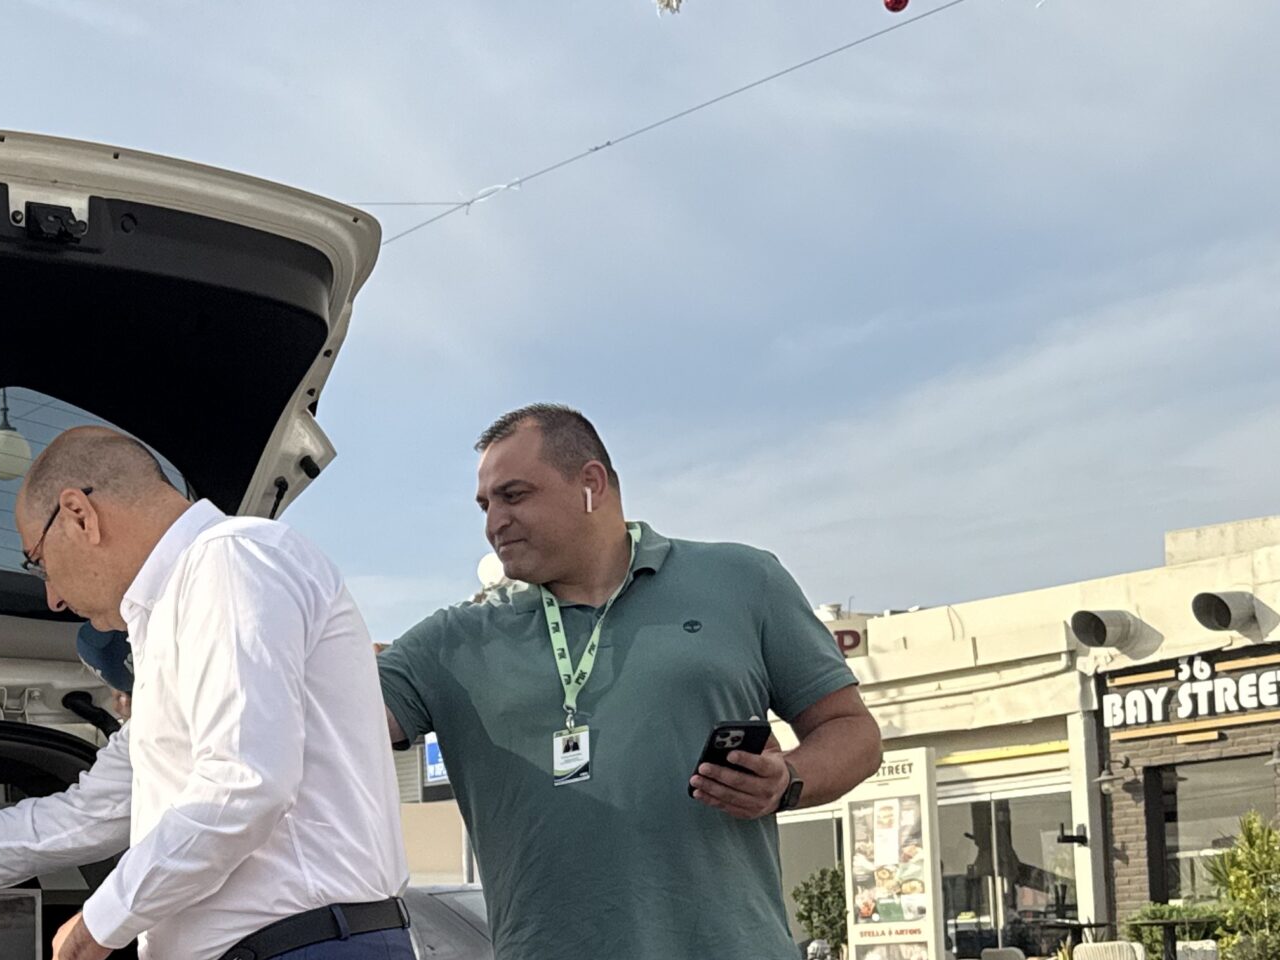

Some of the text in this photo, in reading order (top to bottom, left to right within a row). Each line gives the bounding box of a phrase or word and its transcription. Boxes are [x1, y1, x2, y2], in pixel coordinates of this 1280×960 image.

[1178, 656, 1211, 681] 36
[1103, 669, 1280, 728] BAY STREE
[859, 930, 886, 938] STELLA
